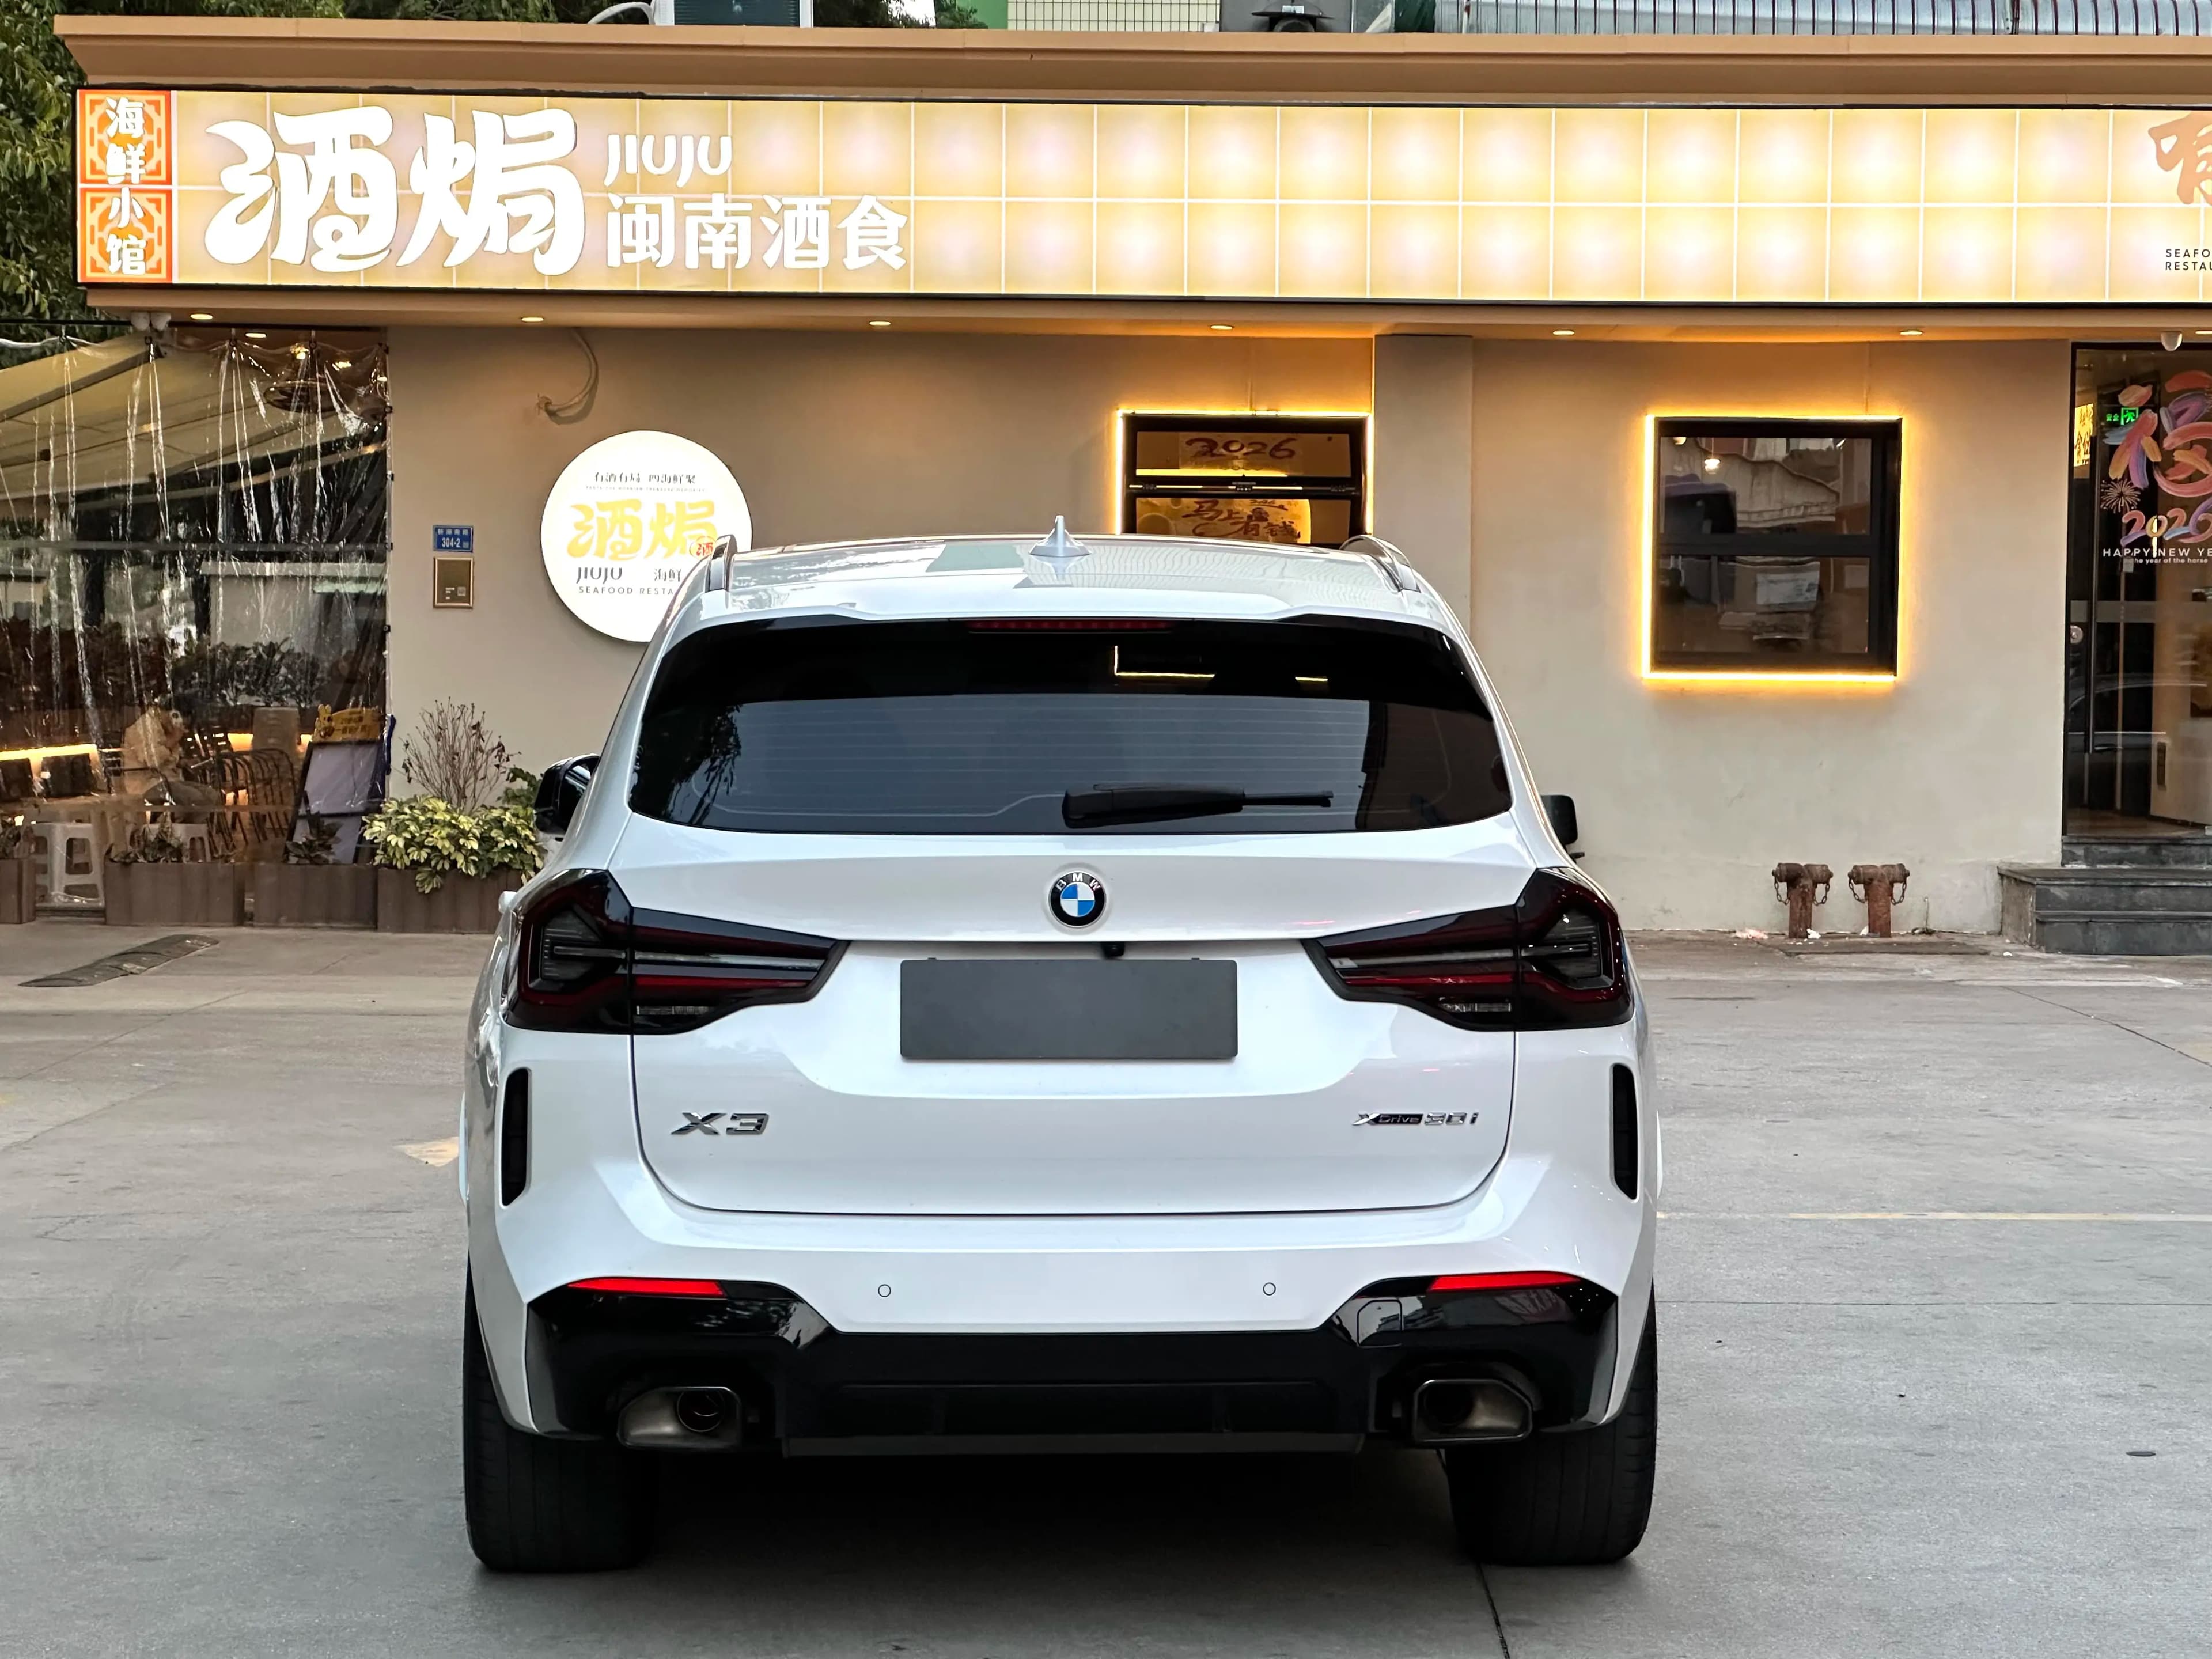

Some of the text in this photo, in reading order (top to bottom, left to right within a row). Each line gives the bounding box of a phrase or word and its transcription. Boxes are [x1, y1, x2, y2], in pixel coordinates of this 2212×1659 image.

[604, 134, 732, 187] JIUJU
[105, 97, 146, 275] 海鲜小馆
[607, 192, 908, 270] 闽南酒食
[2165, 249, 2210, 258] SEAFO
[1185, 437, 1298, 459] 2026
[2103, 548, 2150, 557] HAPPY
[2158, 548, 2190, 557] NEW
[576, 566, 623, 584] JIUJU
[578, 586, 633, 594] SEAFOOD
[1055, 872, 1101, 891] BMW
[670, 1112, 770, 1135] X3
